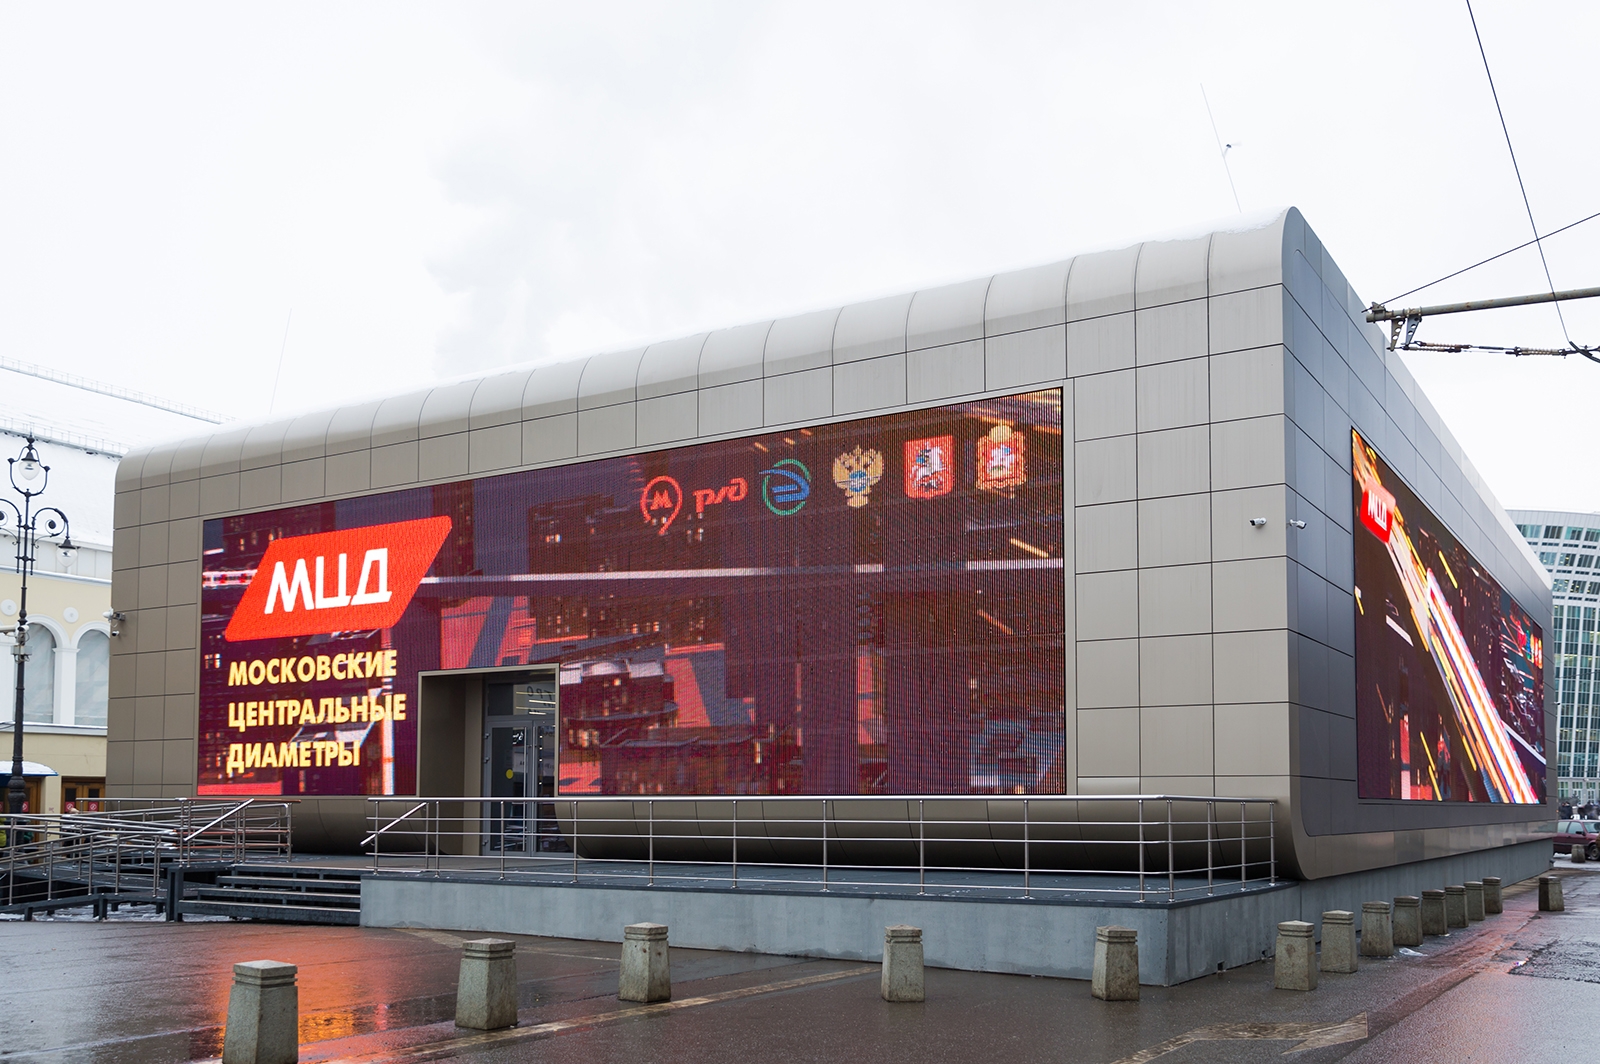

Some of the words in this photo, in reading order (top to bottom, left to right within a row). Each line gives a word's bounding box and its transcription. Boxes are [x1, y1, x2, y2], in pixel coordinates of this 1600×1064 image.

[1368, 489, 1388, 531] МЦД
[264, 548, 393, 615] МЦД
[228, 650, 397, 687] МОСКОВСКИЕ
[228, 694, 406, 732] ЦЕНТРАЛЬНЫЕ
[226, 741, 361, 774] ДИАМЕТРЫ
